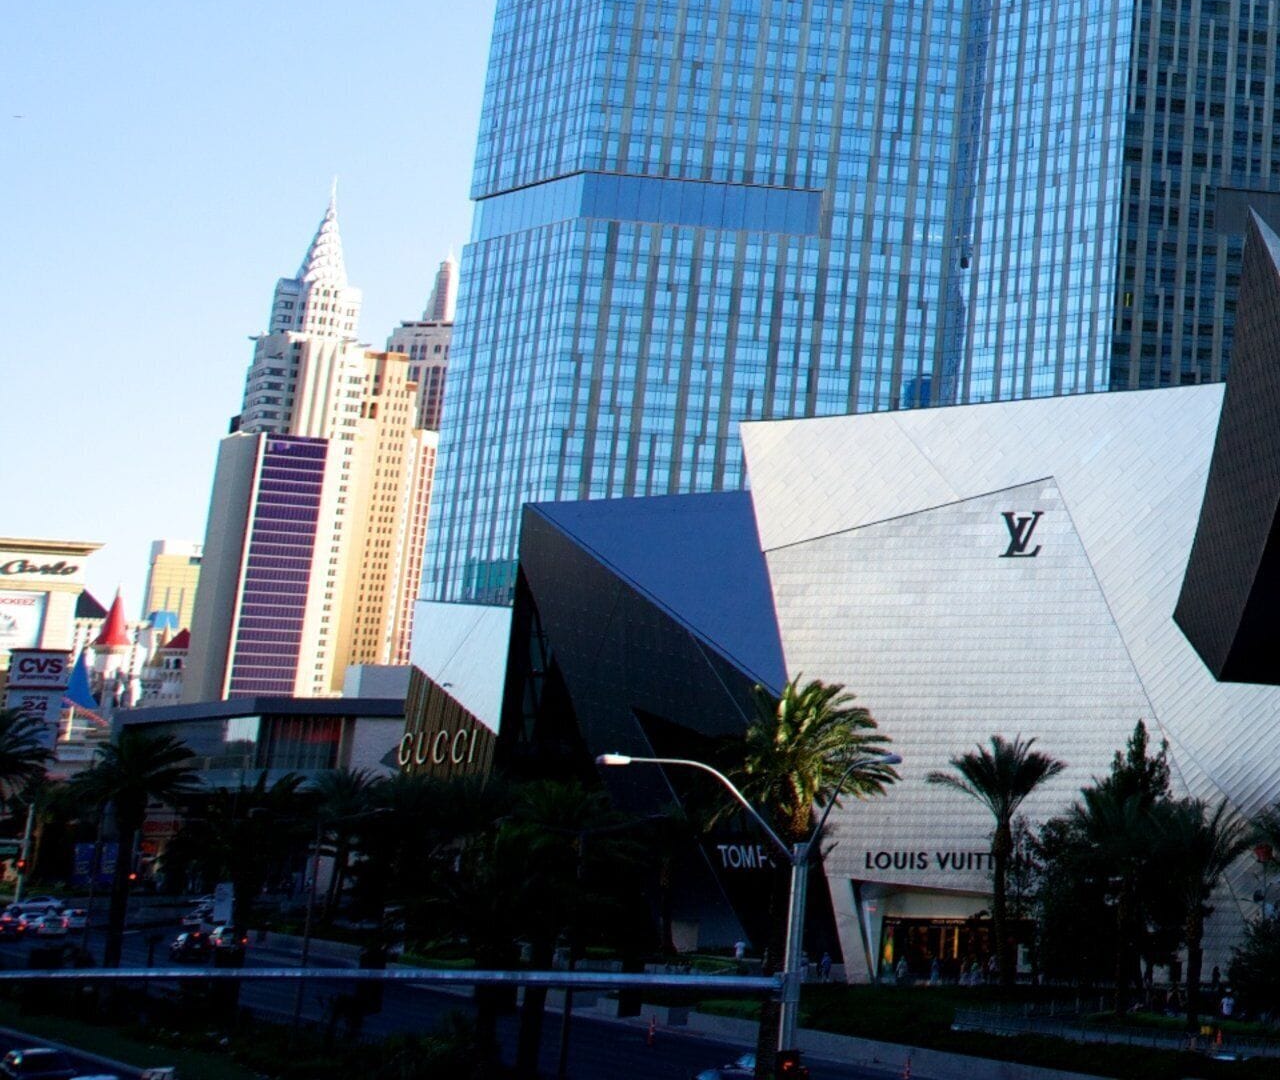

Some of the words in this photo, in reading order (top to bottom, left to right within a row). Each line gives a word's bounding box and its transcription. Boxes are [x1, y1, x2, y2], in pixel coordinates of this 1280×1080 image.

[18, 657, 63, 674] CVS
[22, 701, 48, 712] 24
[398, 728, 478, 767] GUCCI
[716, 843, 757, 870] TOM
[865, 851, 928, 870] LOUIS
[936, 851, 1032, 871] VUITTN
